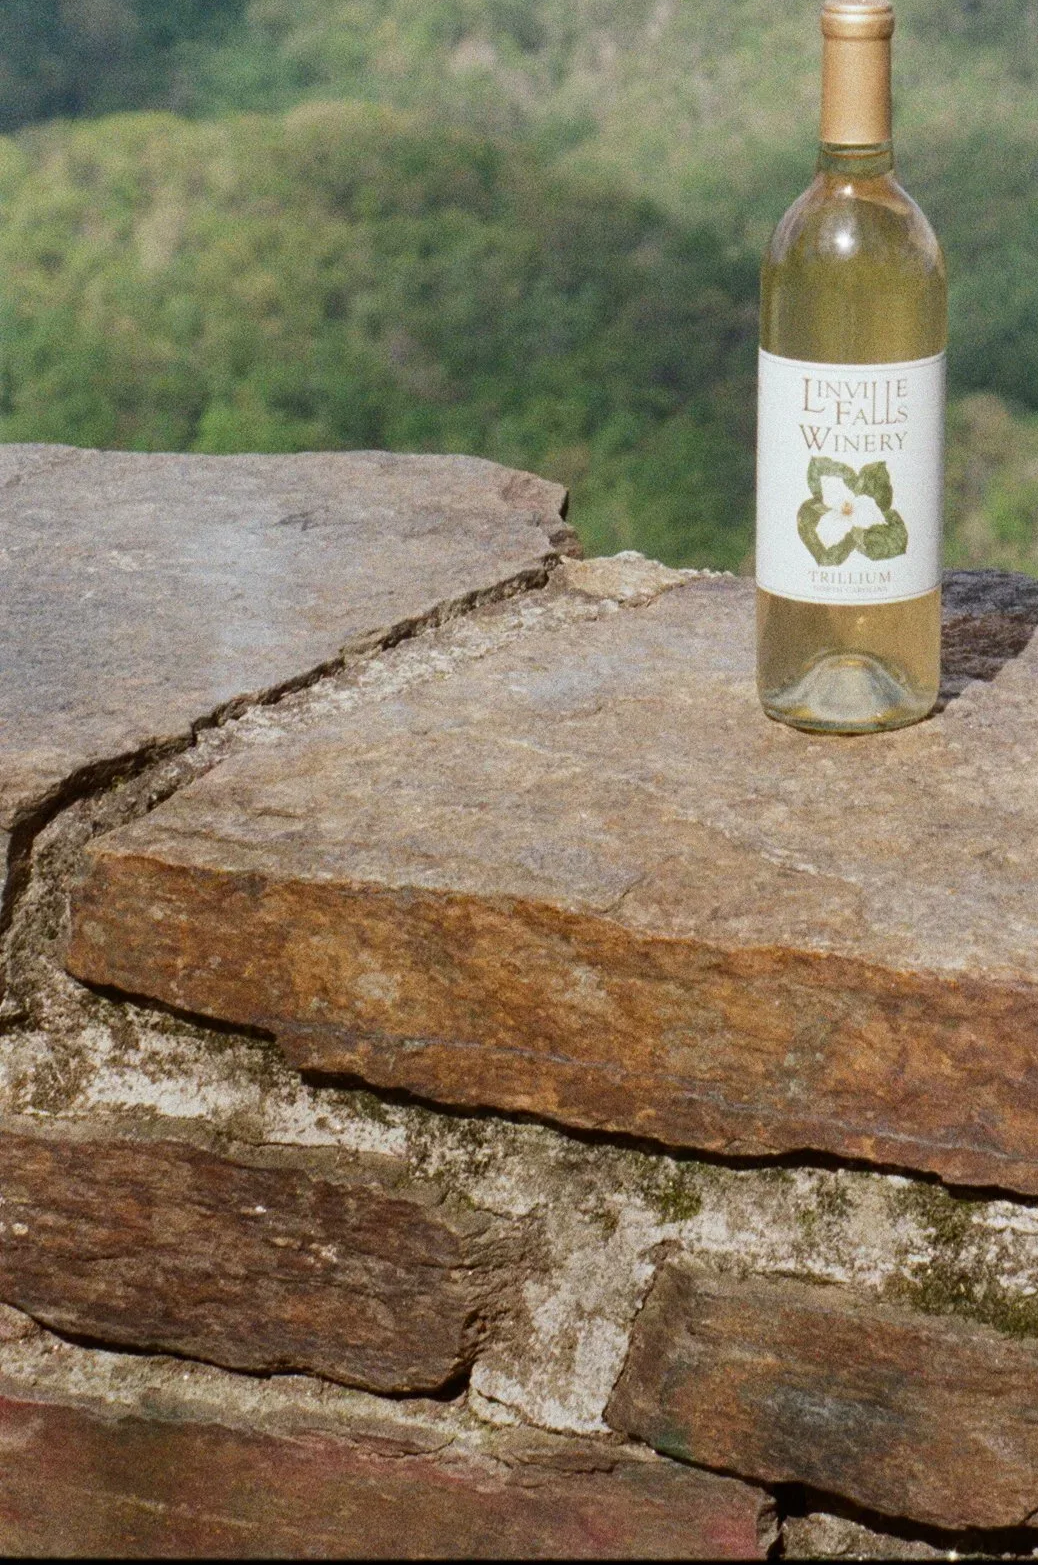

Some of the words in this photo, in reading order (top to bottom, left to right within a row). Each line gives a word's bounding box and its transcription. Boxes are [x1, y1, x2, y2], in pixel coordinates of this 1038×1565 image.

[802, 377, 908, 413] LINVILLE
[836, 400, 908, 426] FALLS
[799, 423, 908, 453] WINERY
[808, 570, 891, 585] TRILLIUM
